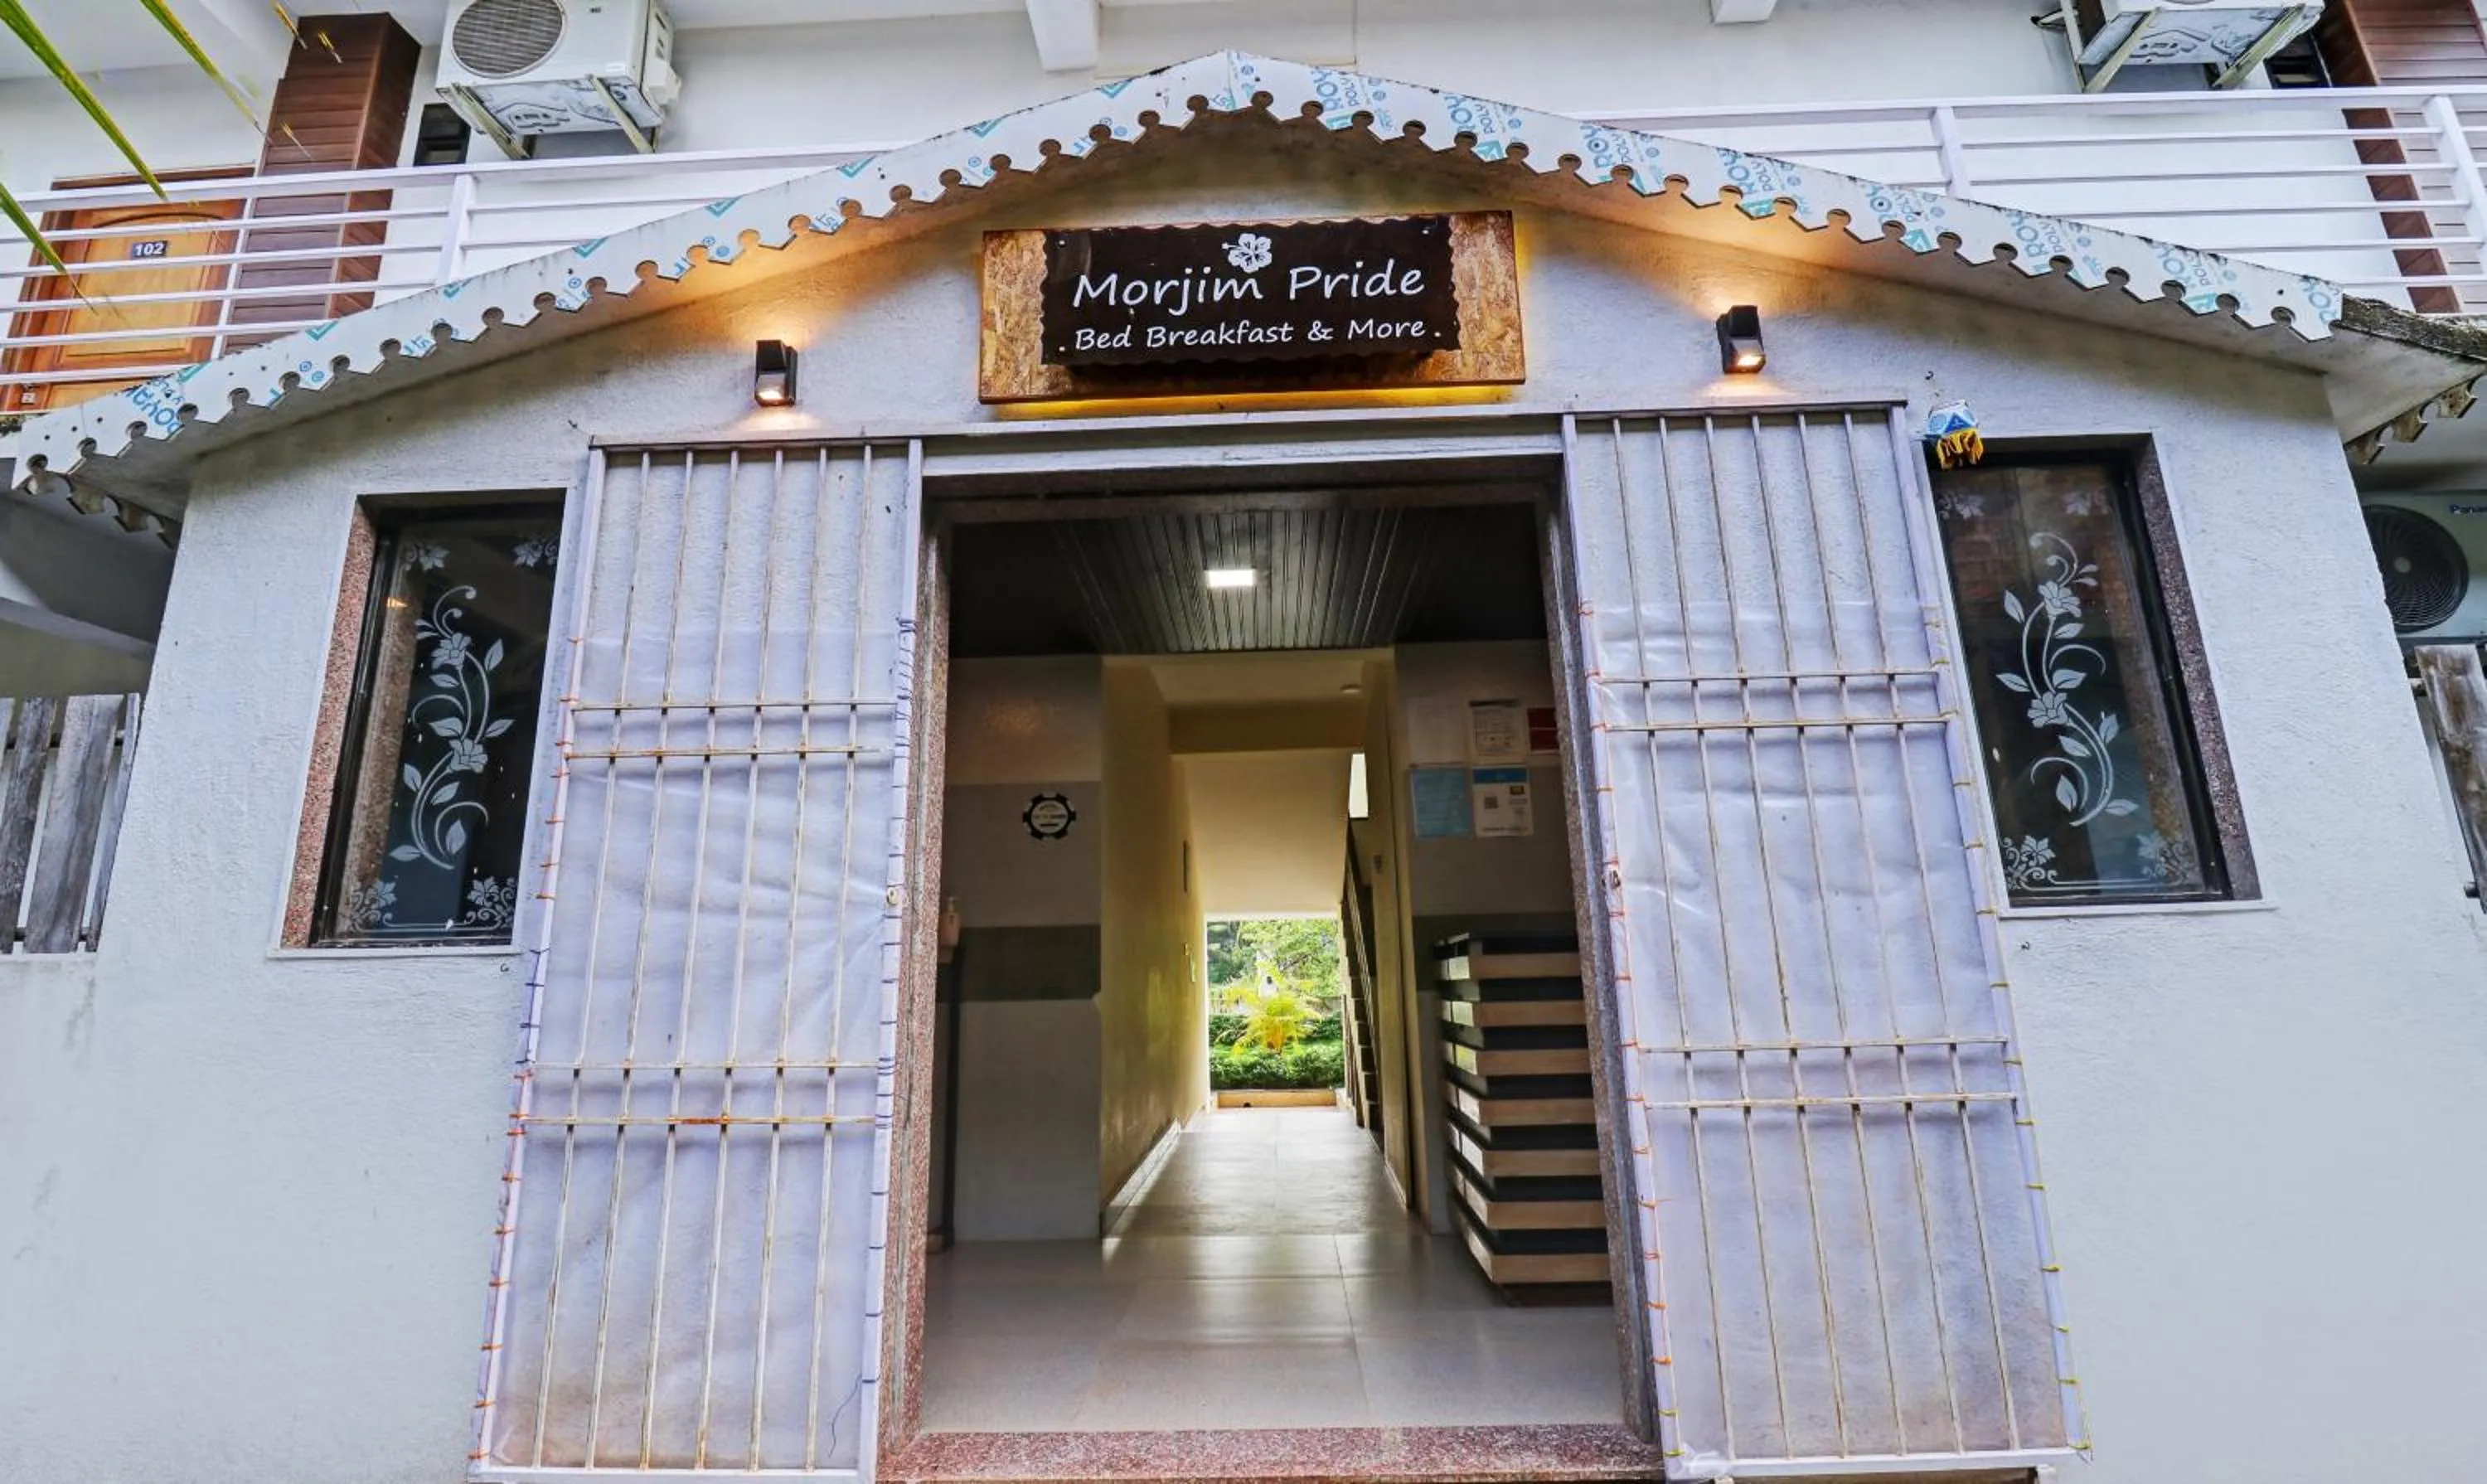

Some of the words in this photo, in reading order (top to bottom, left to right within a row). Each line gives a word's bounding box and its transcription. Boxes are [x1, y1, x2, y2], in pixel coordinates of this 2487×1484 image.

[135, 242, 164, 255] 102
[1073, 266, 1263, 316] Morjim
[1289, 258, 1425, 300] Pride
[1075, 324, 1132, 351] Bed
[1147, 319, 1295, 348] Breakfast
[1307, 320, 1334, 341] &
[1347, 318, 1426, 341] More
